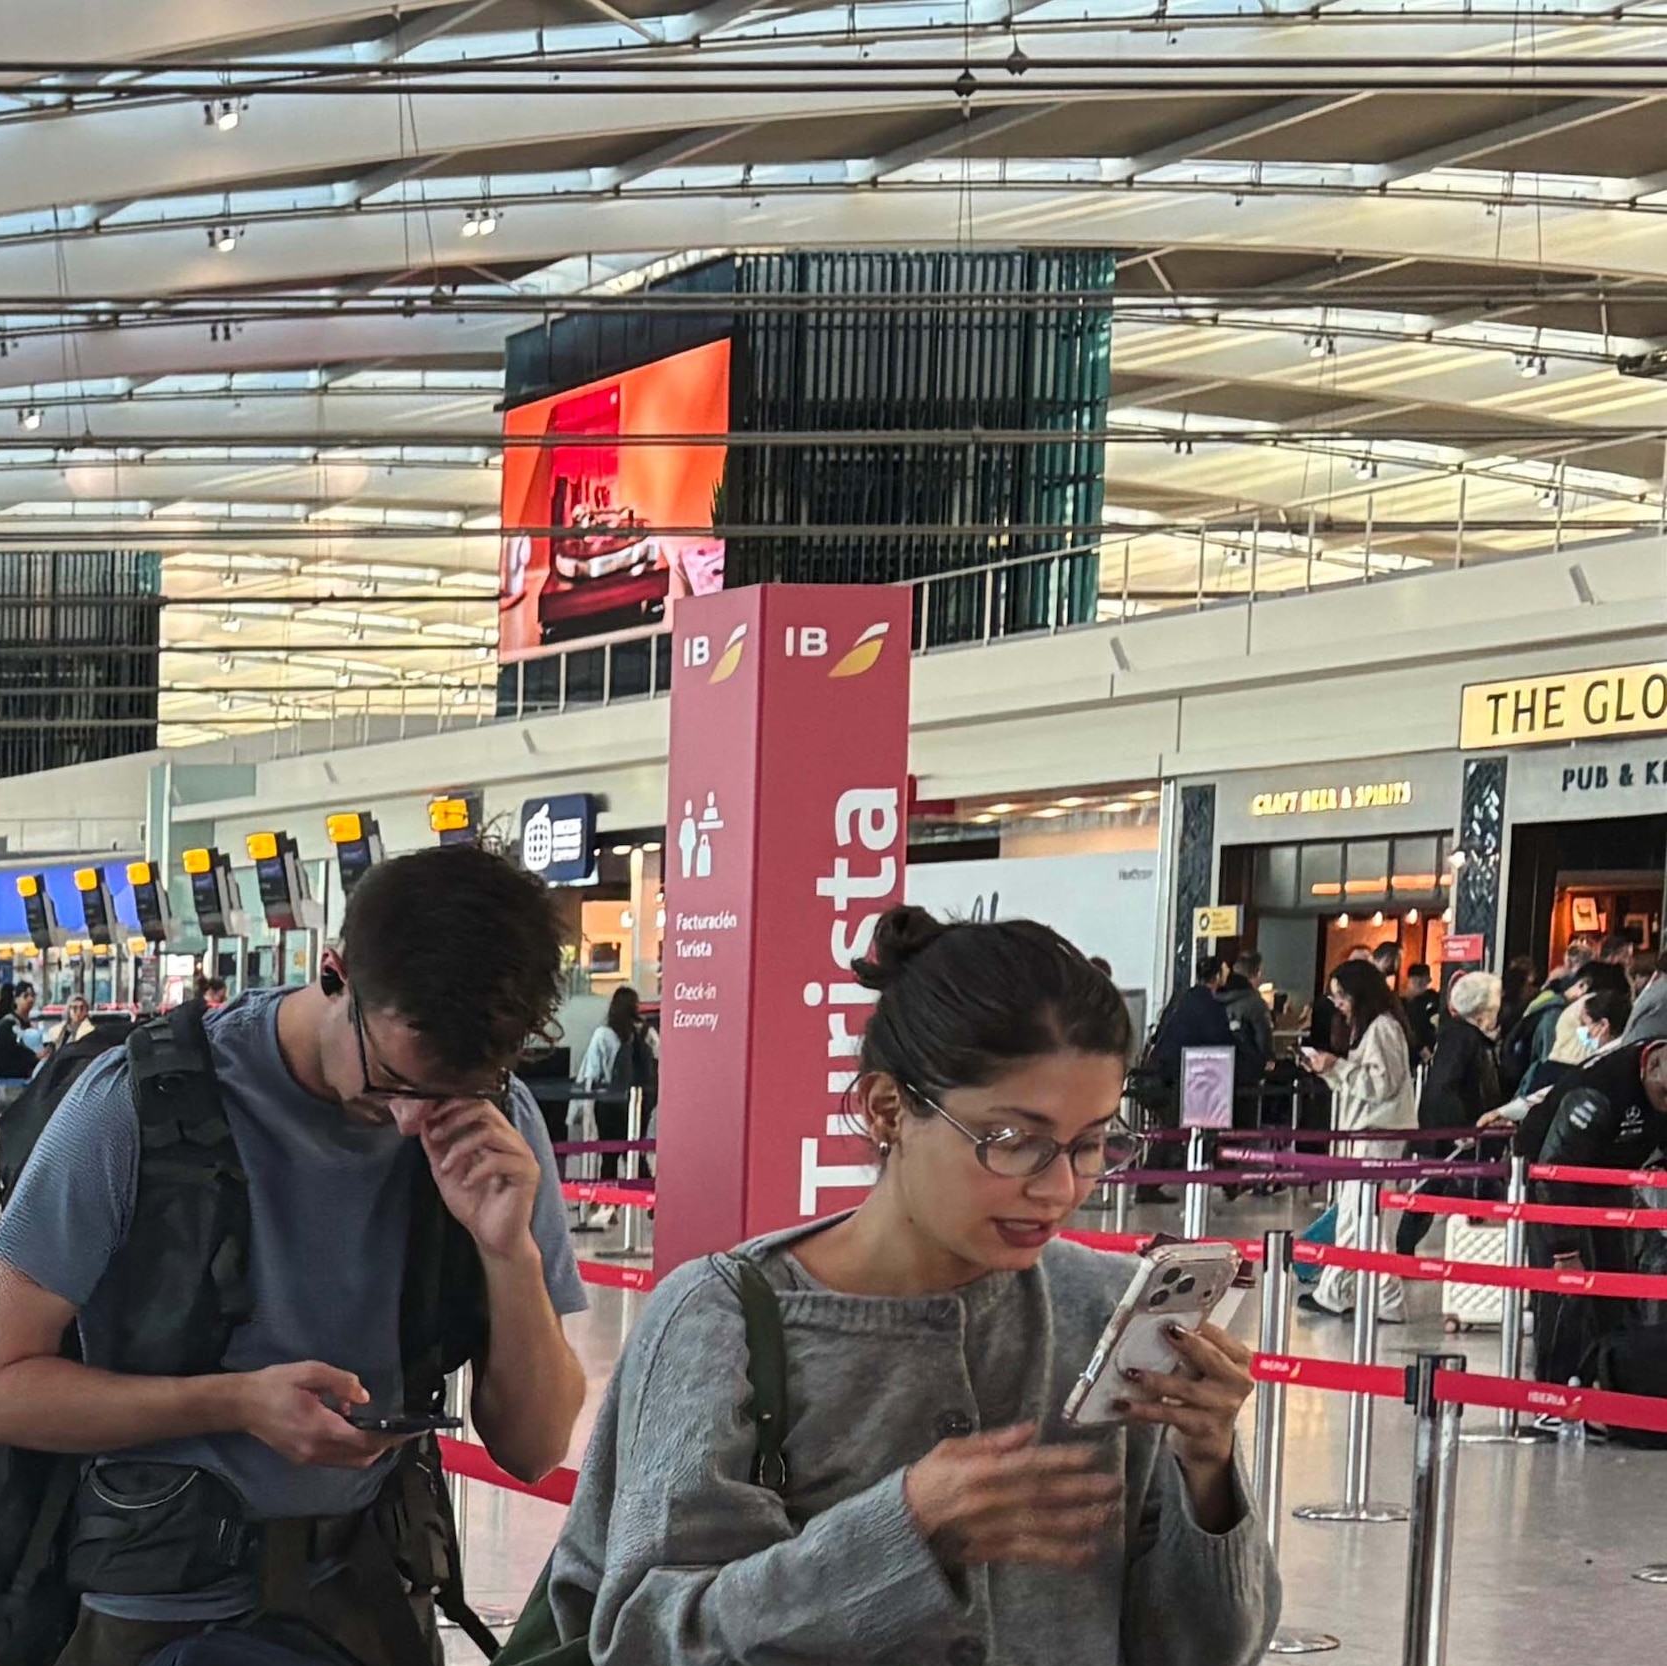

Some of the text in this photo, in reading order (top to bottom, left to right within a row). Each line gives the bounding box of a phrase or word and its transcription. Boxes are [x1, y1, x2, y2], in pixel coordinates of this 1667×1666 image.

[683, 636, 709, 667] IB
[785, 626, 828, 657] IB
[1487, 673, 1667, 735] THE GLO
[1562, 765, 1608, 791] PUB
[1619, 763, 1634, 787] &
[676, 911, 737, 931] Facturación
[675, 940, 712, 957] Turista
[674, 982, 716, 1000] Check-in
[673, 1009, 718, 1031] Economy
[1528, 1391, 1567, 1406] IBERIA
